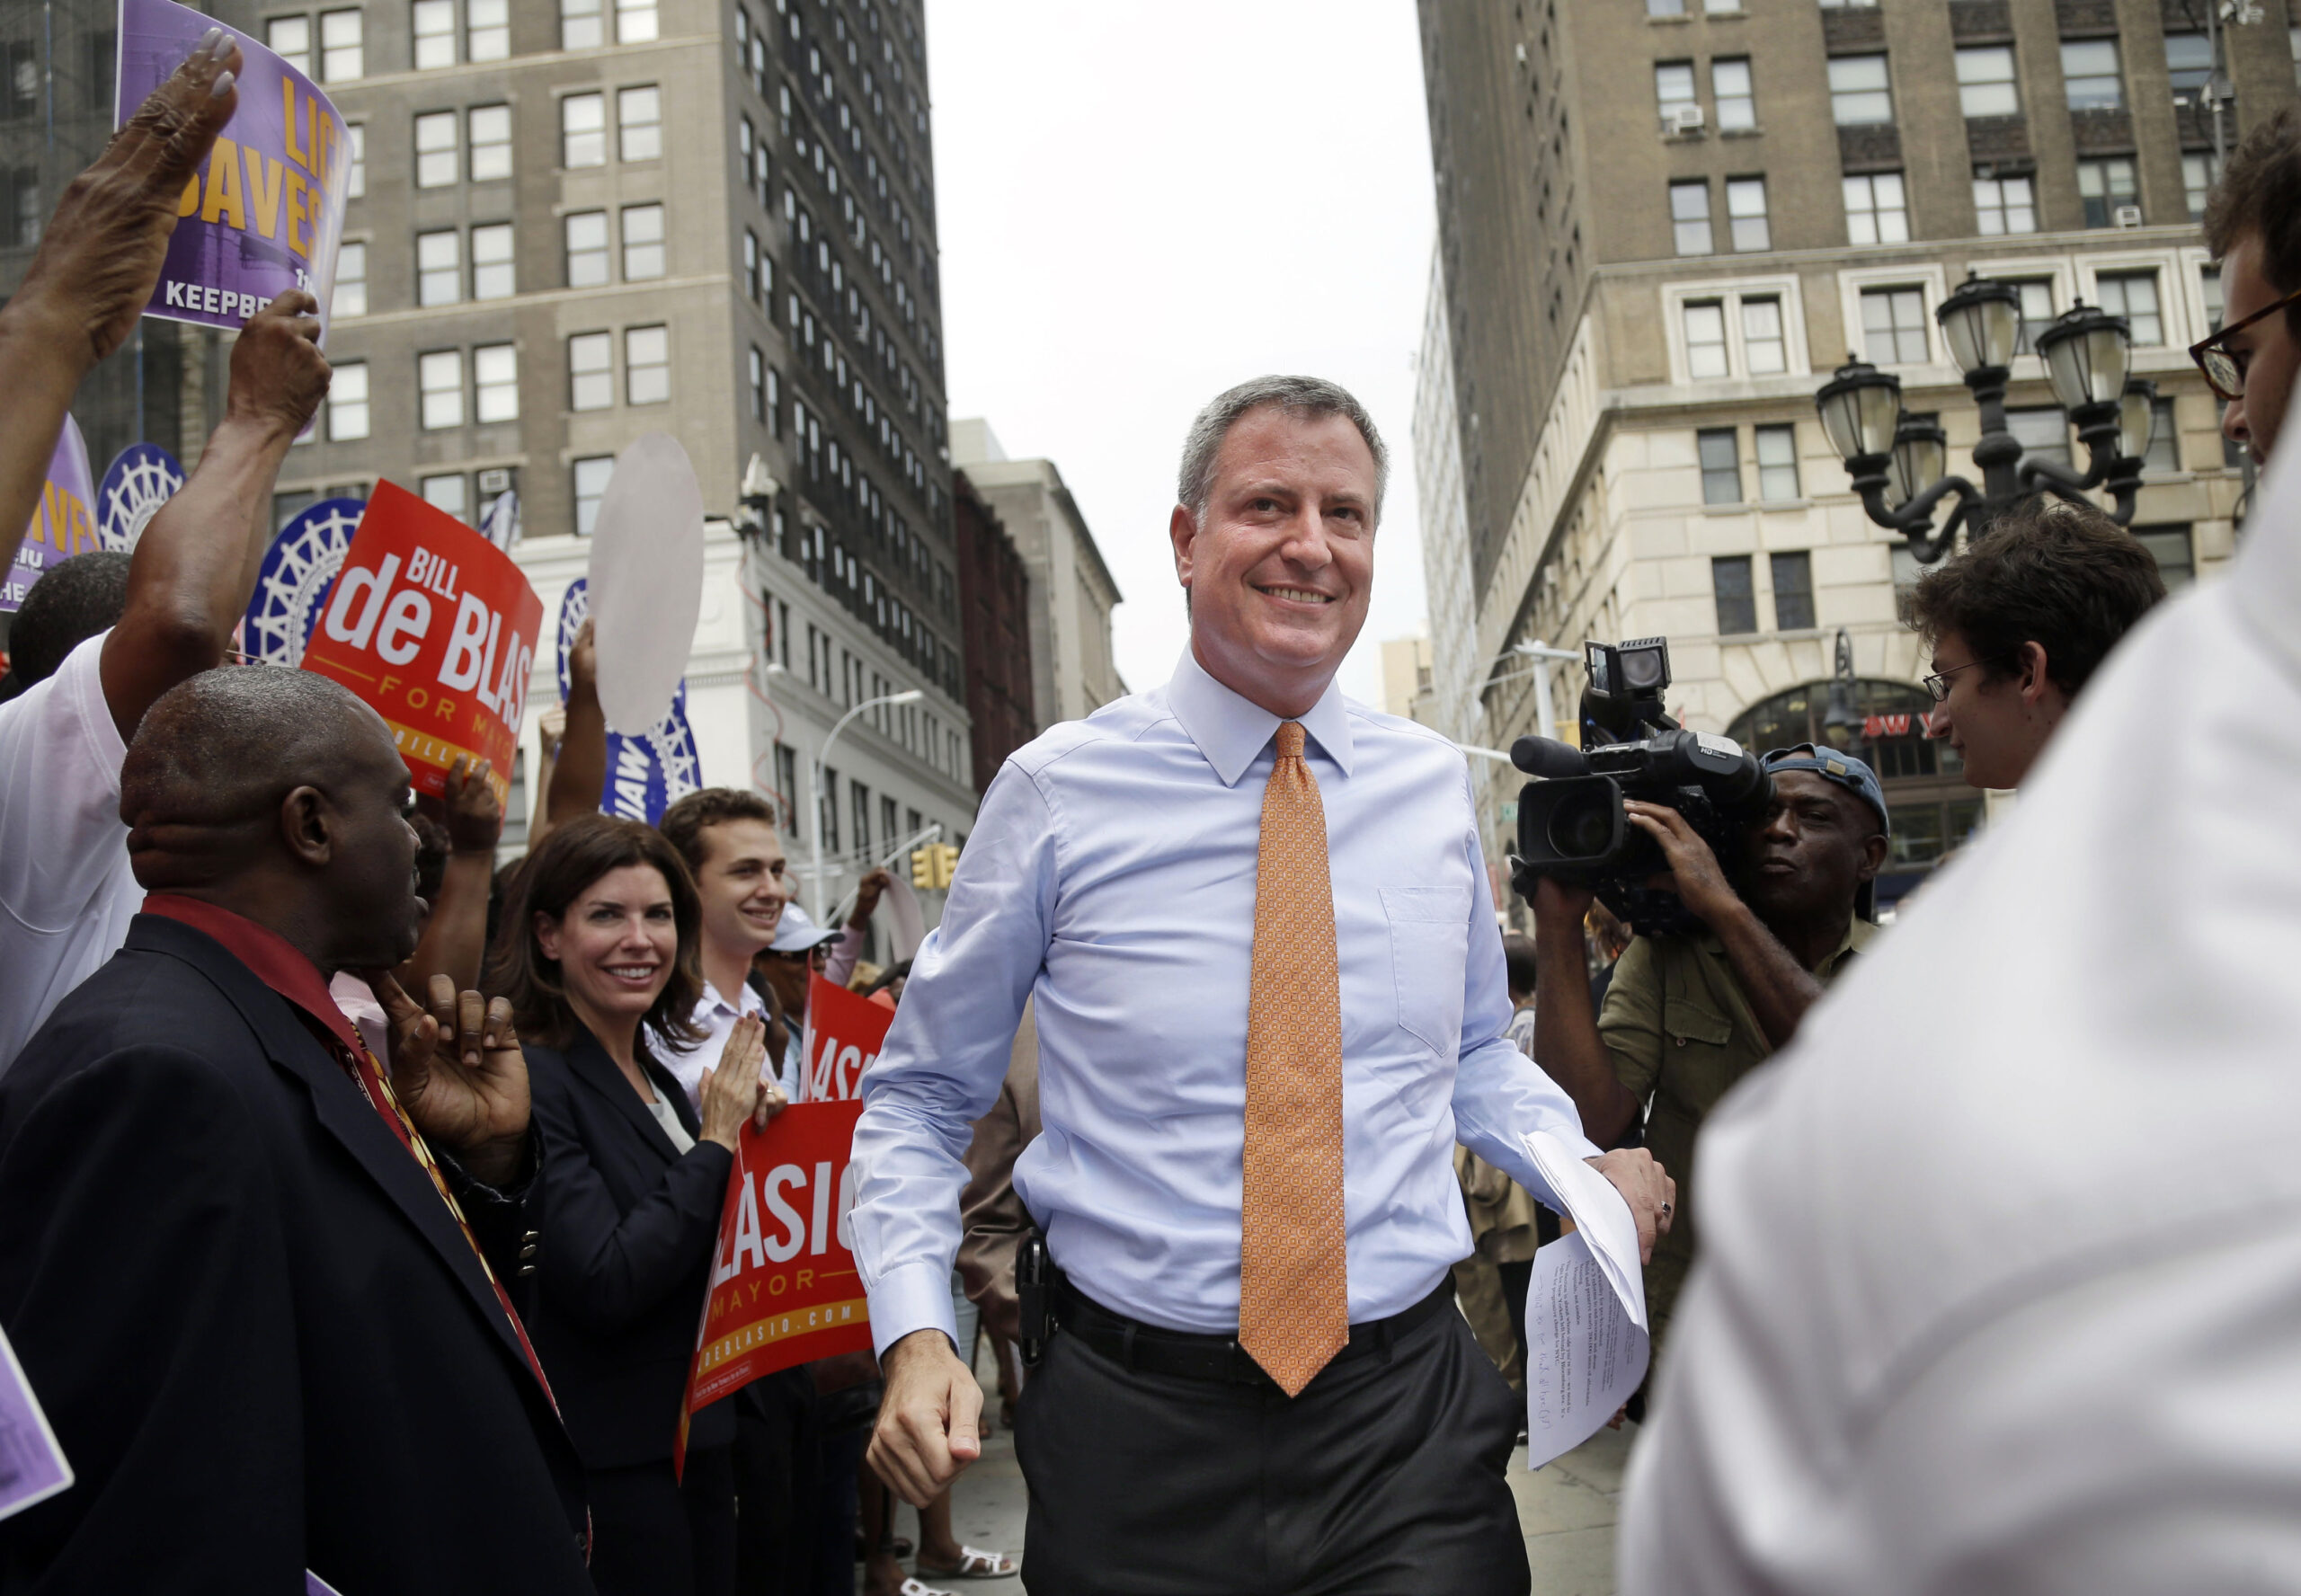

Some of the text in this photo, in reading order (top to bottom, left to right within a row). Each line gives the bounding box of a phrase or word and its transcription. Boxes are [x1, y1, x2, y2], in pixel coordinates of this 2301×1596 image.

[405, 545, 458, 601] BILL
[324, 552, 431, 666] de
[378, 676, 458, 723] FOR
[614, 736, 651, 824] UAW
[712, 1268, 814, 1322] MAYOR
